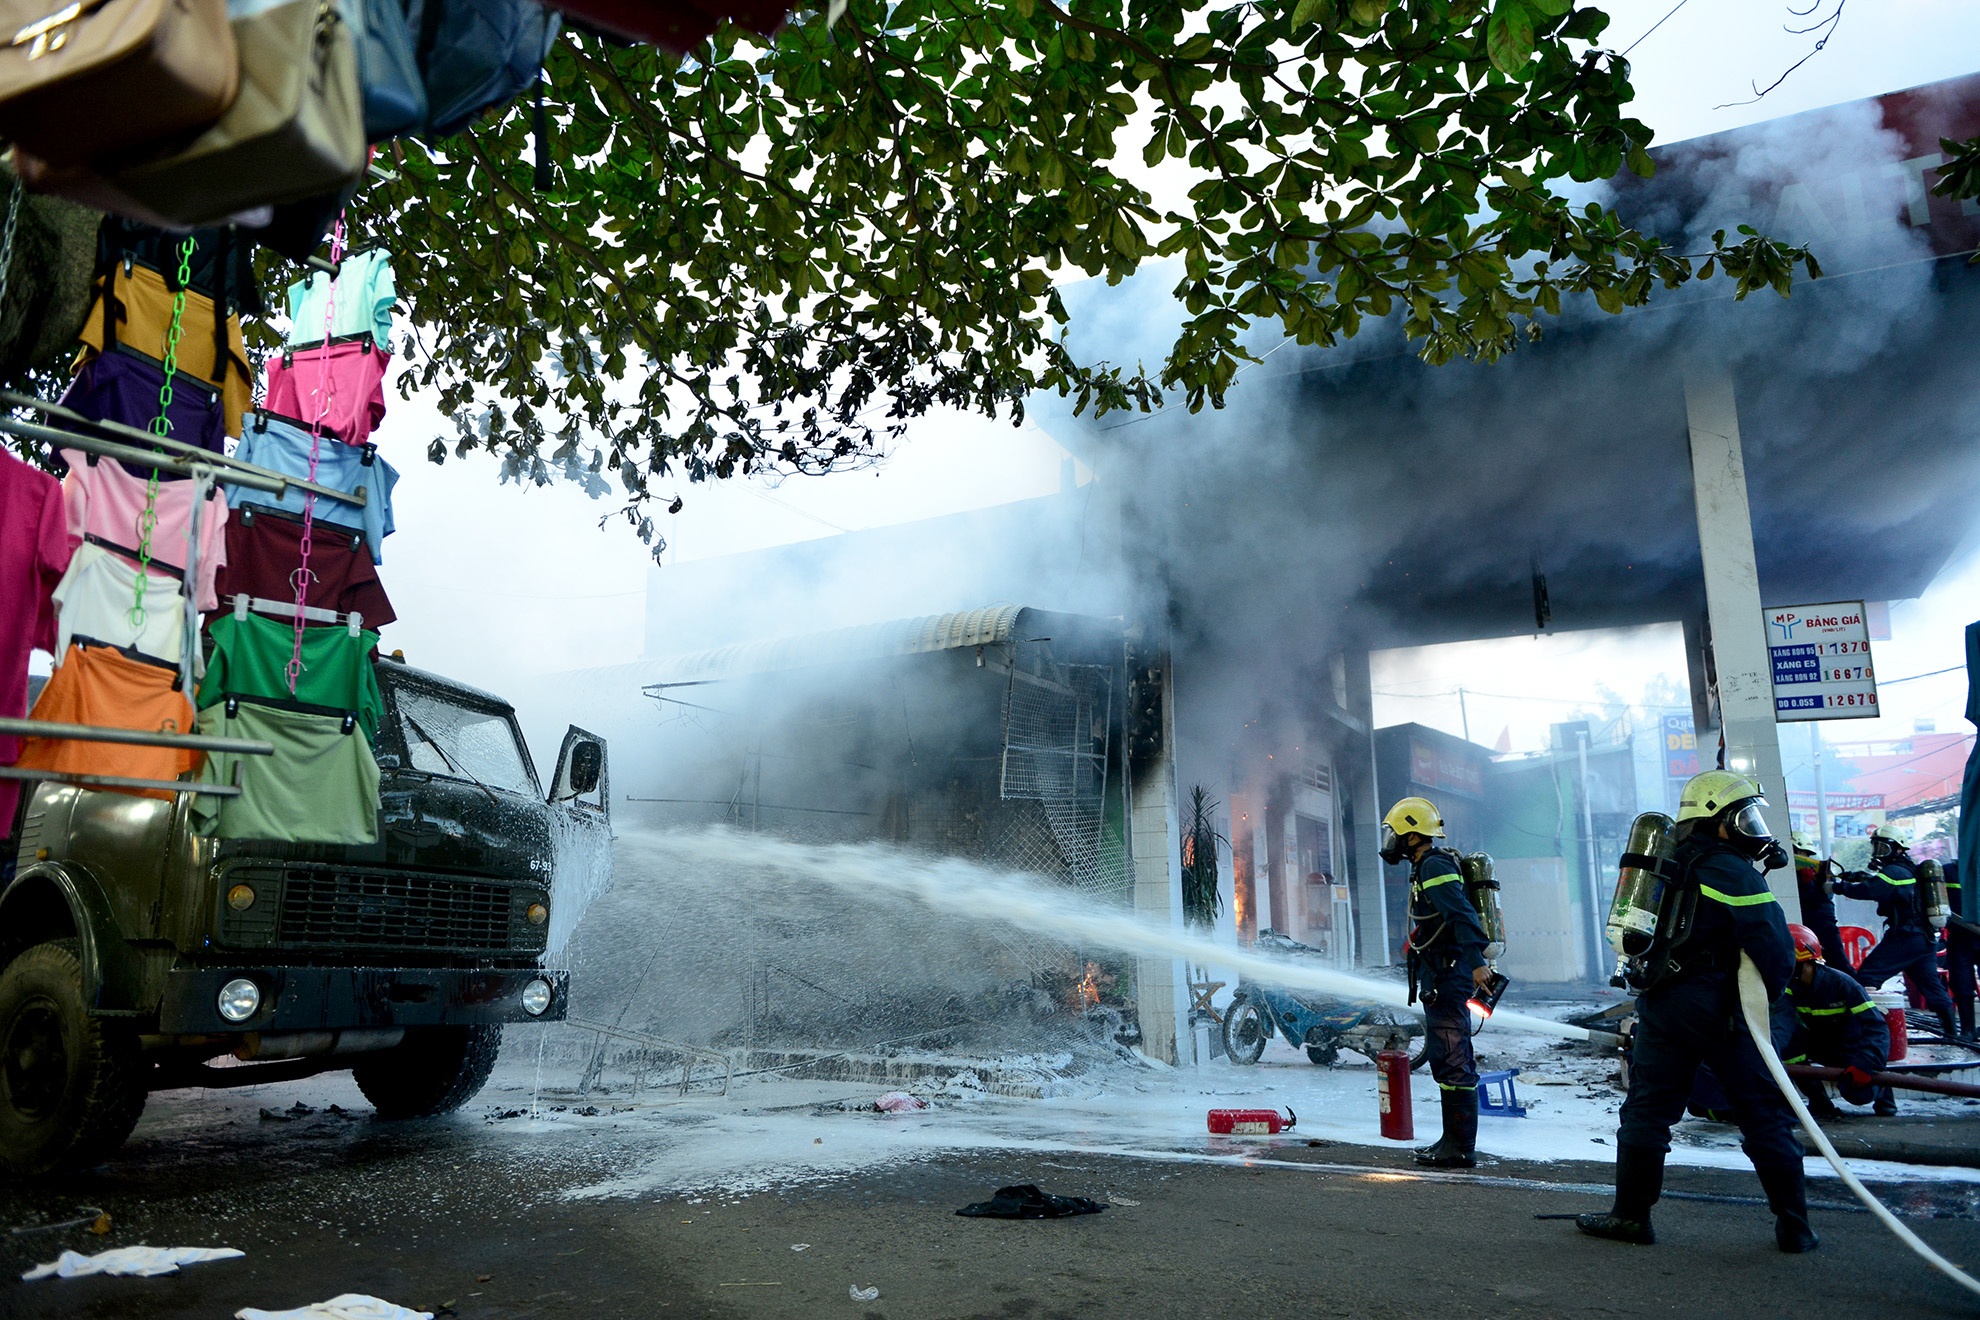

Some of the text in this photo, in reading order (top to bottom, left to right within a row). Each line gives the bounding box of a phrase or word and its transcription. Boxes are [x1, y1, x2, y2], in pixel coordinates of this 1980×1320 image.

[1806, 613, 1861, 628] BẢNG GIÁ
[1806, 646, 1815, 655] 95
[1818, 641, 1869, 655] 17370
[1804, 659, 1817, 668] E5
[1809, 672, 1818, 680] 92
[1824, 667, 1873, 681] 16670
[1828, 693, 1877, 707] 12670
[1667, 730, 1697, 750] ĐÈ
[530, 859, 552, 871] 67-93
